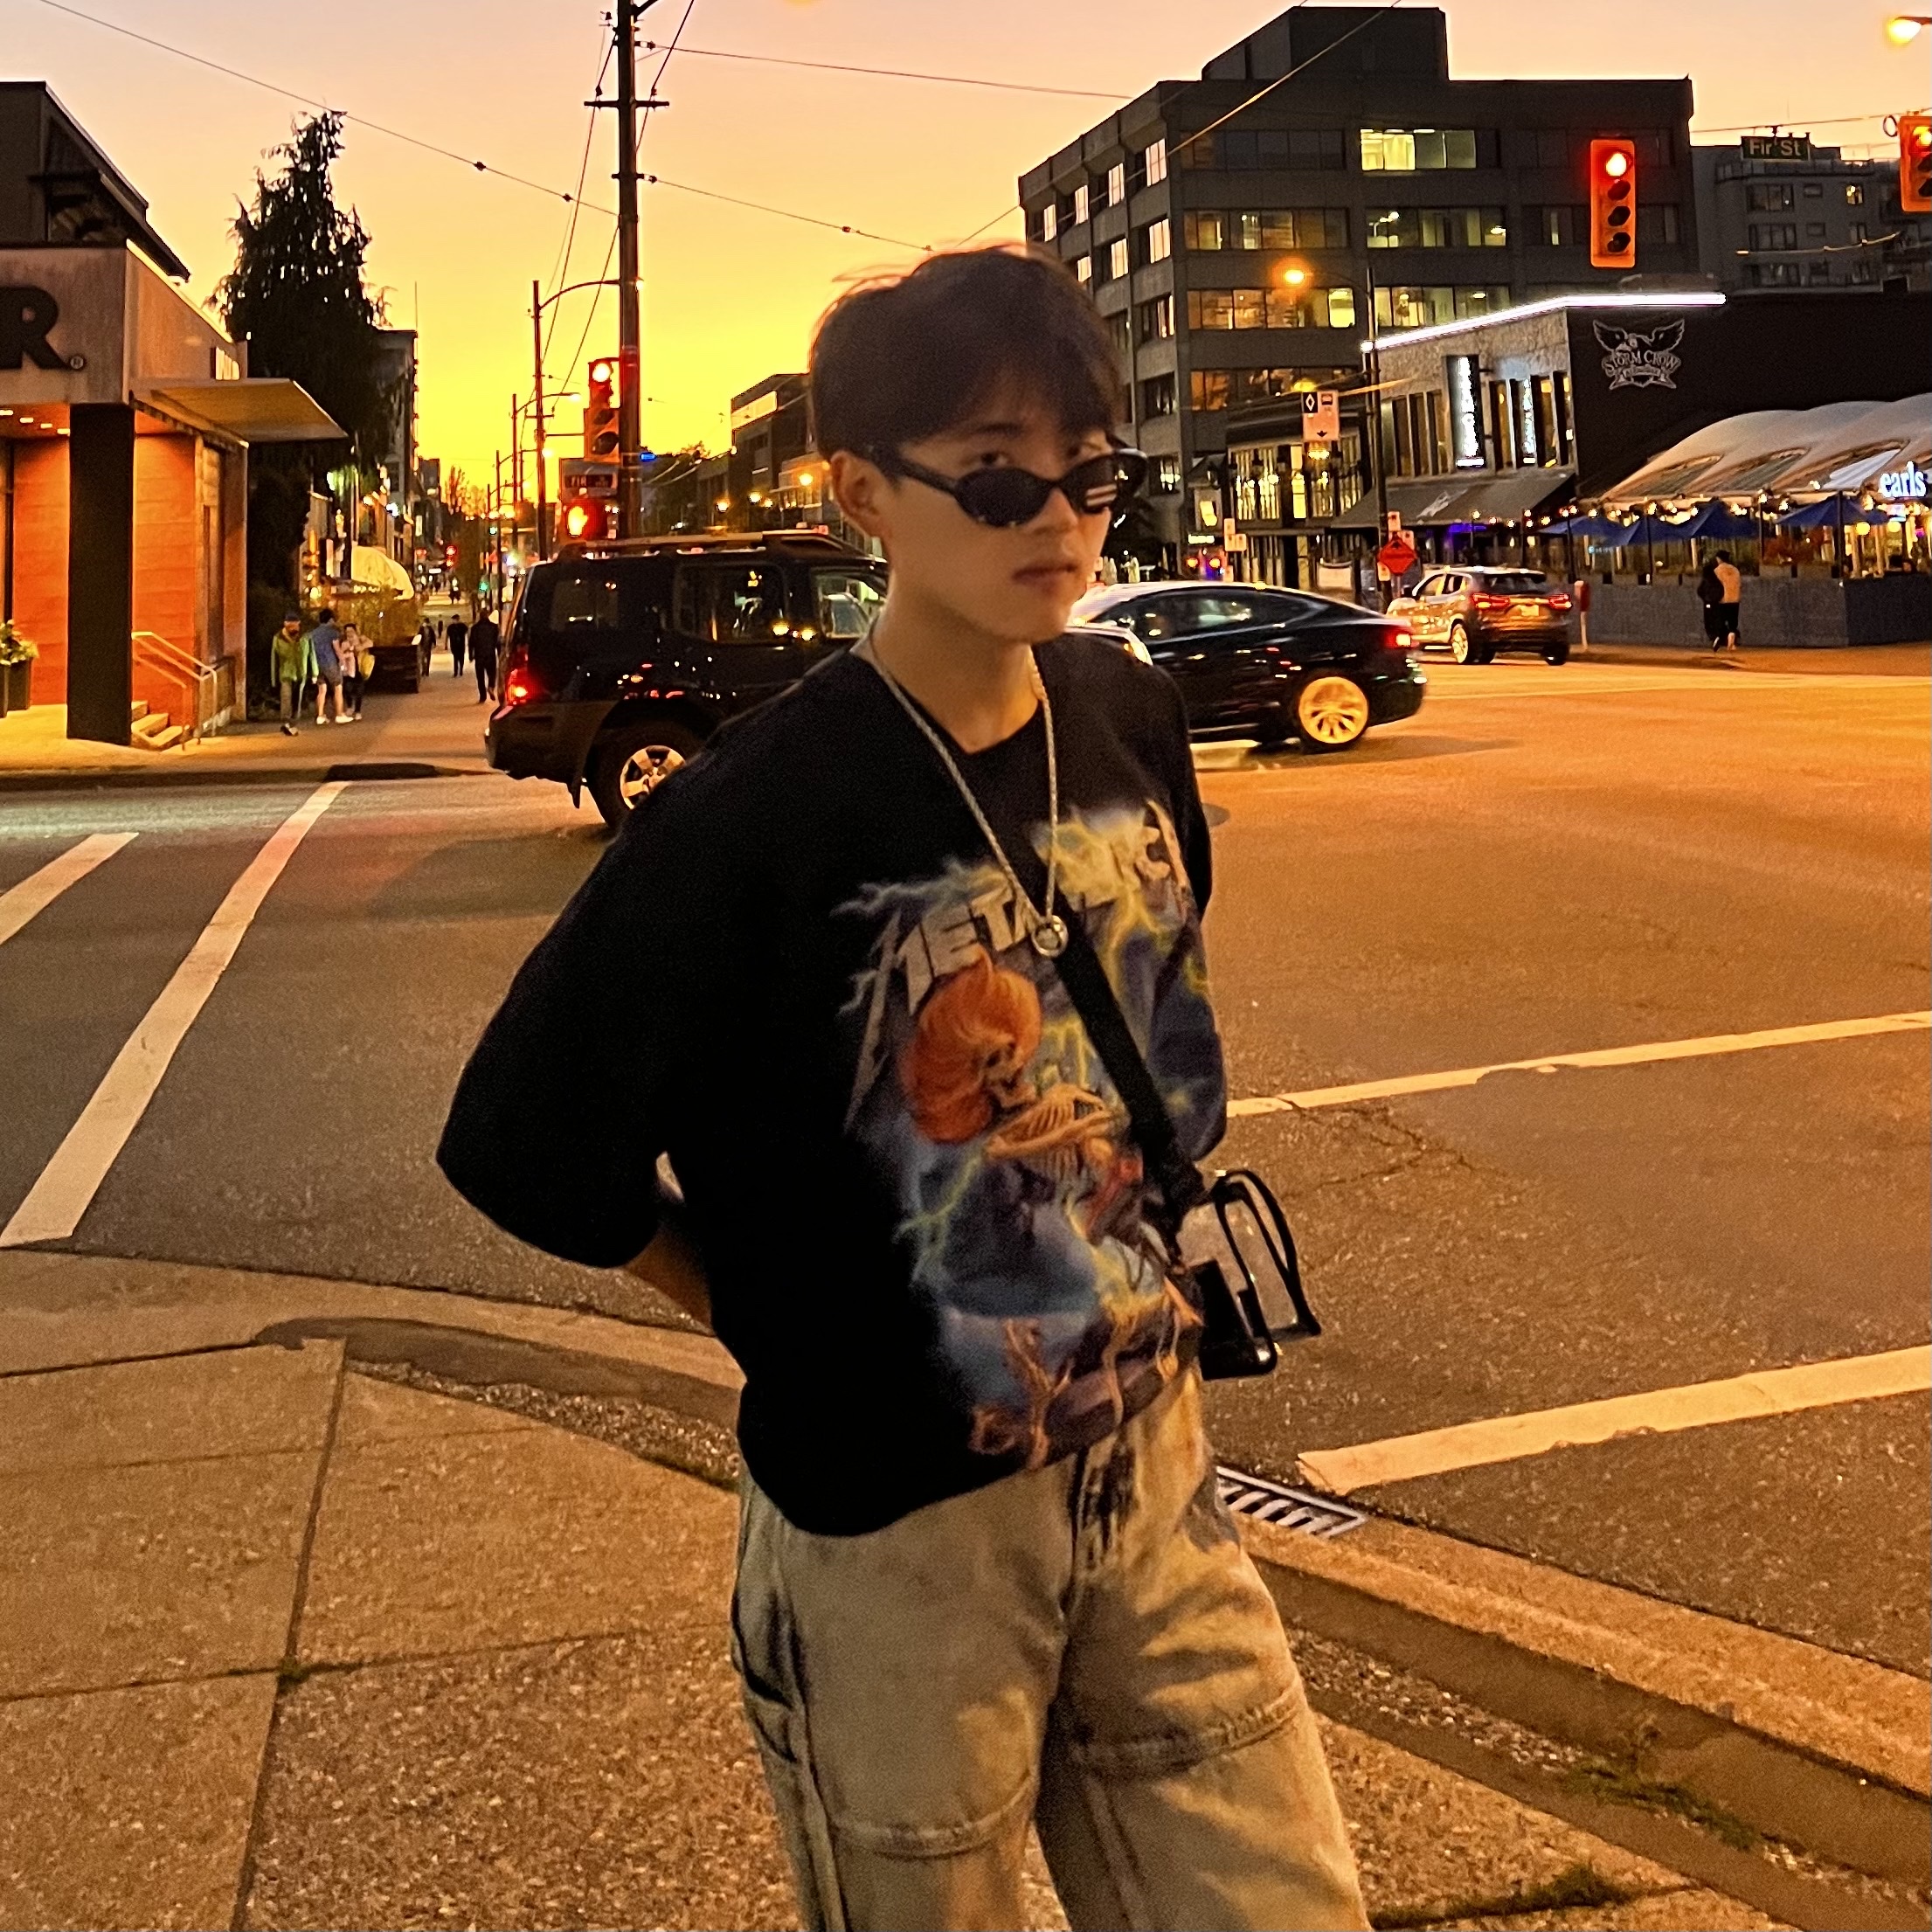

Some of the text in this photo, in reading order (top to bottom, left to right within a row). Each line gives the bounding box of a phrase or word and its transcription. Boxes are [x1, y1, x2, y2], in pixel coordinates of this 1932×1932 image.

[1749, 139, 1801, 156] Fir St
[1604, 349, 1642, 373] STORM
[1643, 349, 1678, 371] CROW
[1880, 460, 1928, 498] earls
